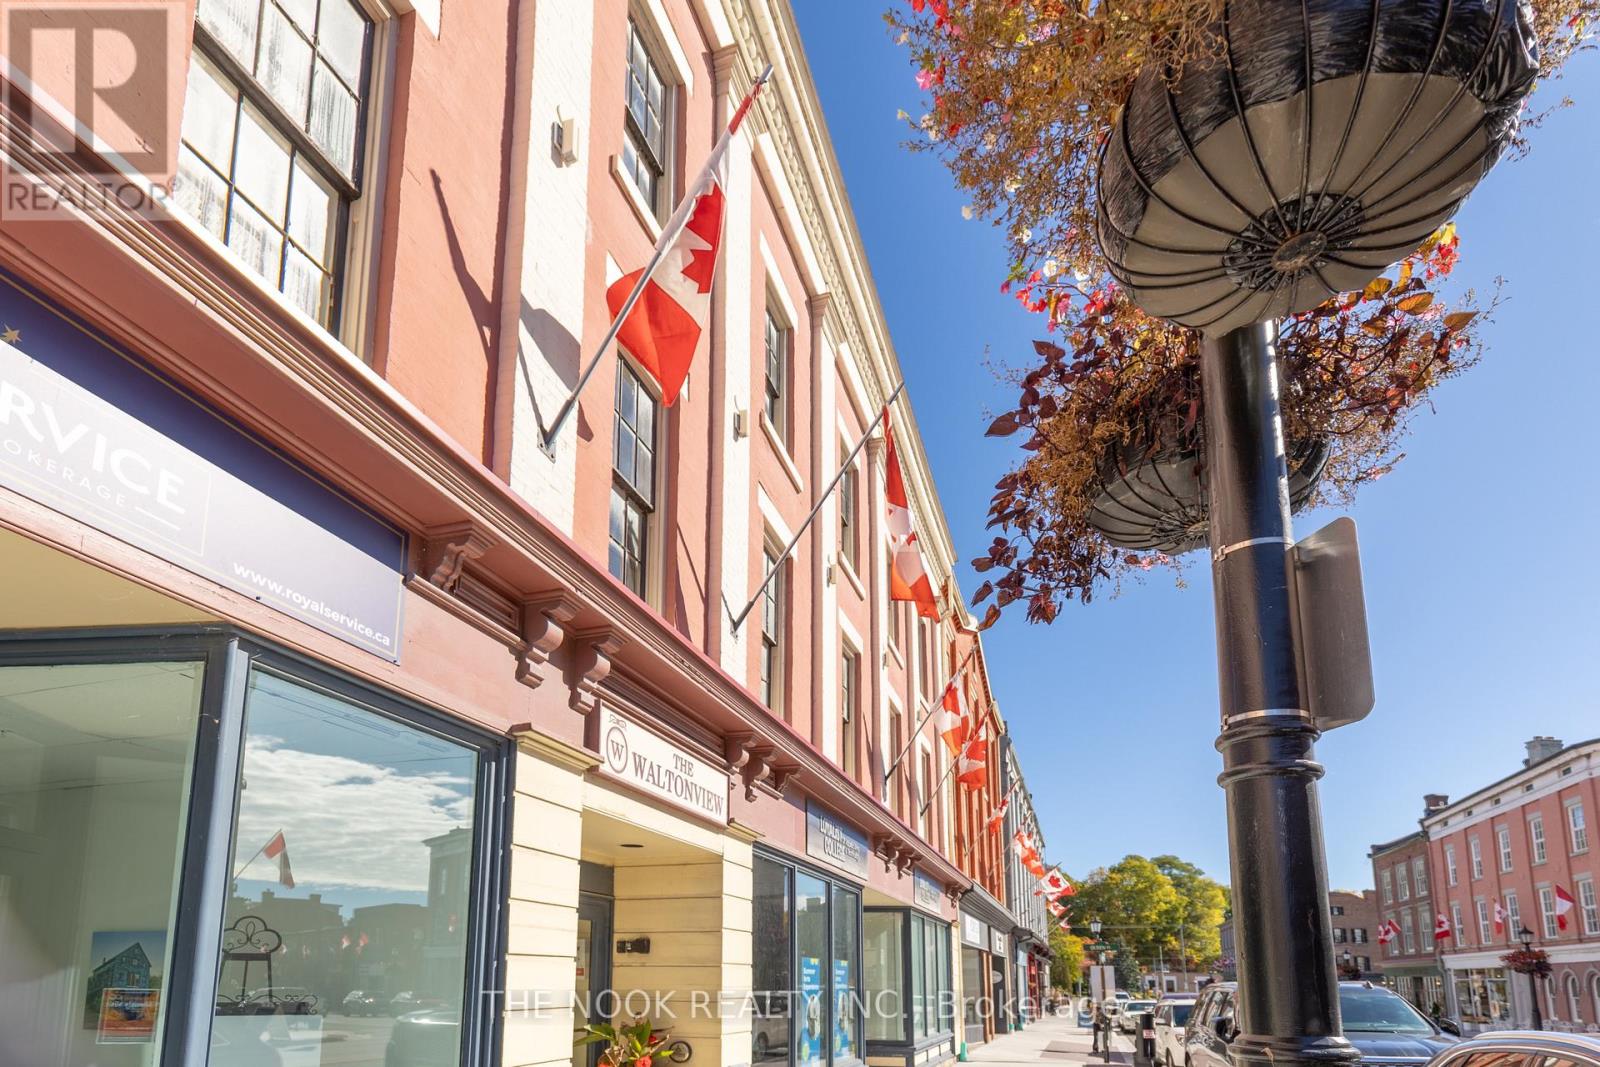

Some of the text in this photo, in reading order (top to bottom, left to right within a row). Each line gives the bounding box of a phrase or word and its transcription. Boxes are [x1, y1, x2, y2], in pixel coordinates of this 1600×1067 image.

[233, 562, 390, 646] www.royalservice.ca
[611, 739, 625, 761] W
[672, 753, 694, 777] THE
[631, 751, 724, 816] WALTONVIEW
